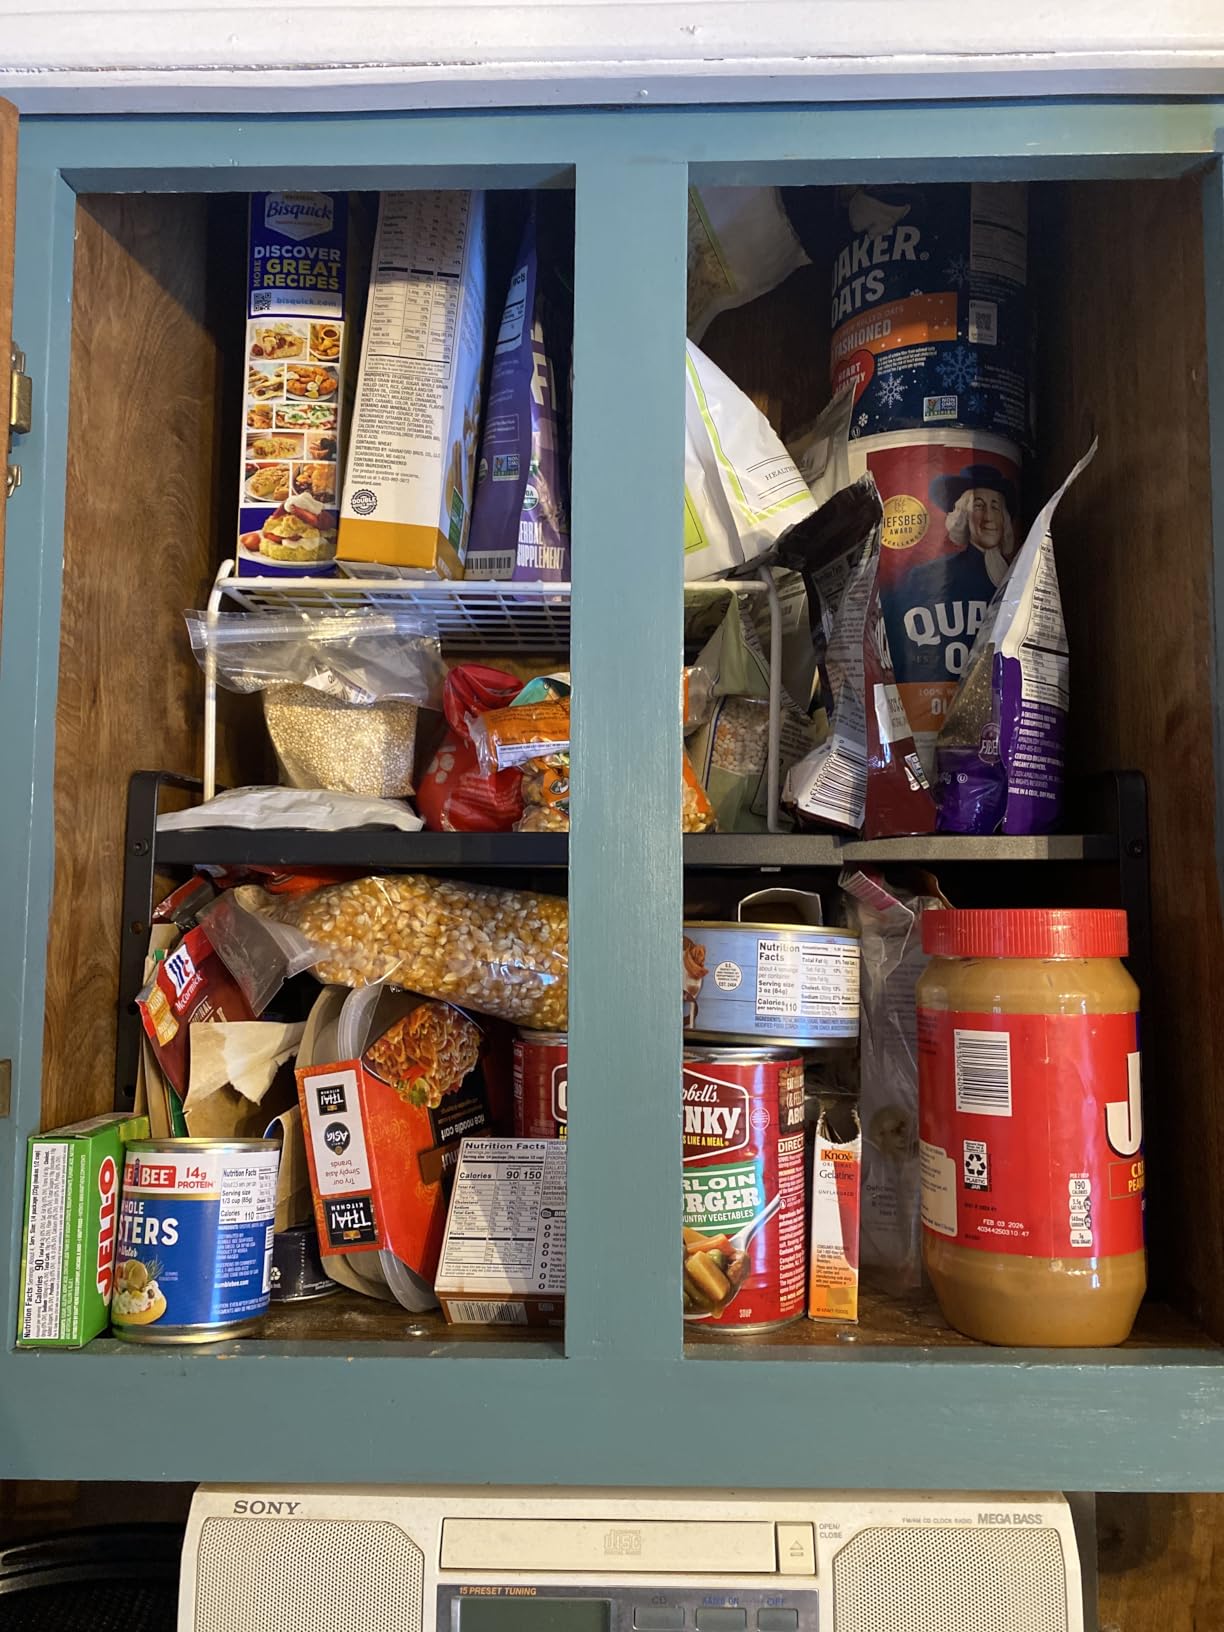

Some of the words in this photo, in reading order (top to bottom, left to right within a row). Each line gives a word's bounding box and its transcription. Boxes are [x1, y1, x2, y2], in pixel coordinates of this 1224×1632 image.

[267, 201, 332, 220] Bisquick
[254, 246, 341, 261] DISCOVER
[266, 258, 341, 277] GREAT
[253, 260, 262, 288] MORE
[264, 275, 340, 290] RECIPES
[276, 297, 338, 308] bisquick.com
[517, 544, 565, 569] SUPPLEMENT
[760, 942, 800, 952] Nutrition
[760, 952, 784, 961] Facts
[321, 1093, 344, 1106] THAI
[455, 1118, 474, 1134] noodle
[327, 1130, 348, 1142] Asia
[441, 1126, 454, 1141] cart
[687, 1136, 700, 1145] LIKE
[707, 1138, 724, 1146] MEAL
[824, 1151, 850, 1160] Knox
[141, 1168, 170, 1185] BEE
[186, 1167, 207, 1180] 14g
[524, 1171, 542, 1179] 150
[819, 1169, 854, 1179] Gelatine
[1074, 1181, 1085, 1189] 190
[331, 1202, 364, 1211] KITCHEN
[245, 1211, 254, 1220] 110
[332, 1210, 371, 1229] THAI
[708, 1209, 754, 1222] VEGETABLES
[35, 1259, 44, 1271] 90
[35, 1275, 43, 1304] Calories
[739, 1309, 753, 1318] SOUP
[232, 1500, 300, 1516] SONY
[978, 1513, 1010, 1525] MEGA
[1013, 1514, 1042, 1525] BASS
[459, 1586, 468, 1596] 15
[469, 1586, 502, 1596] PRESET
[504, 1586, 537, 1596] TUNING
[652, 1595, 667, 1605] CD
[766, 1598, 784, 1606] OFF
